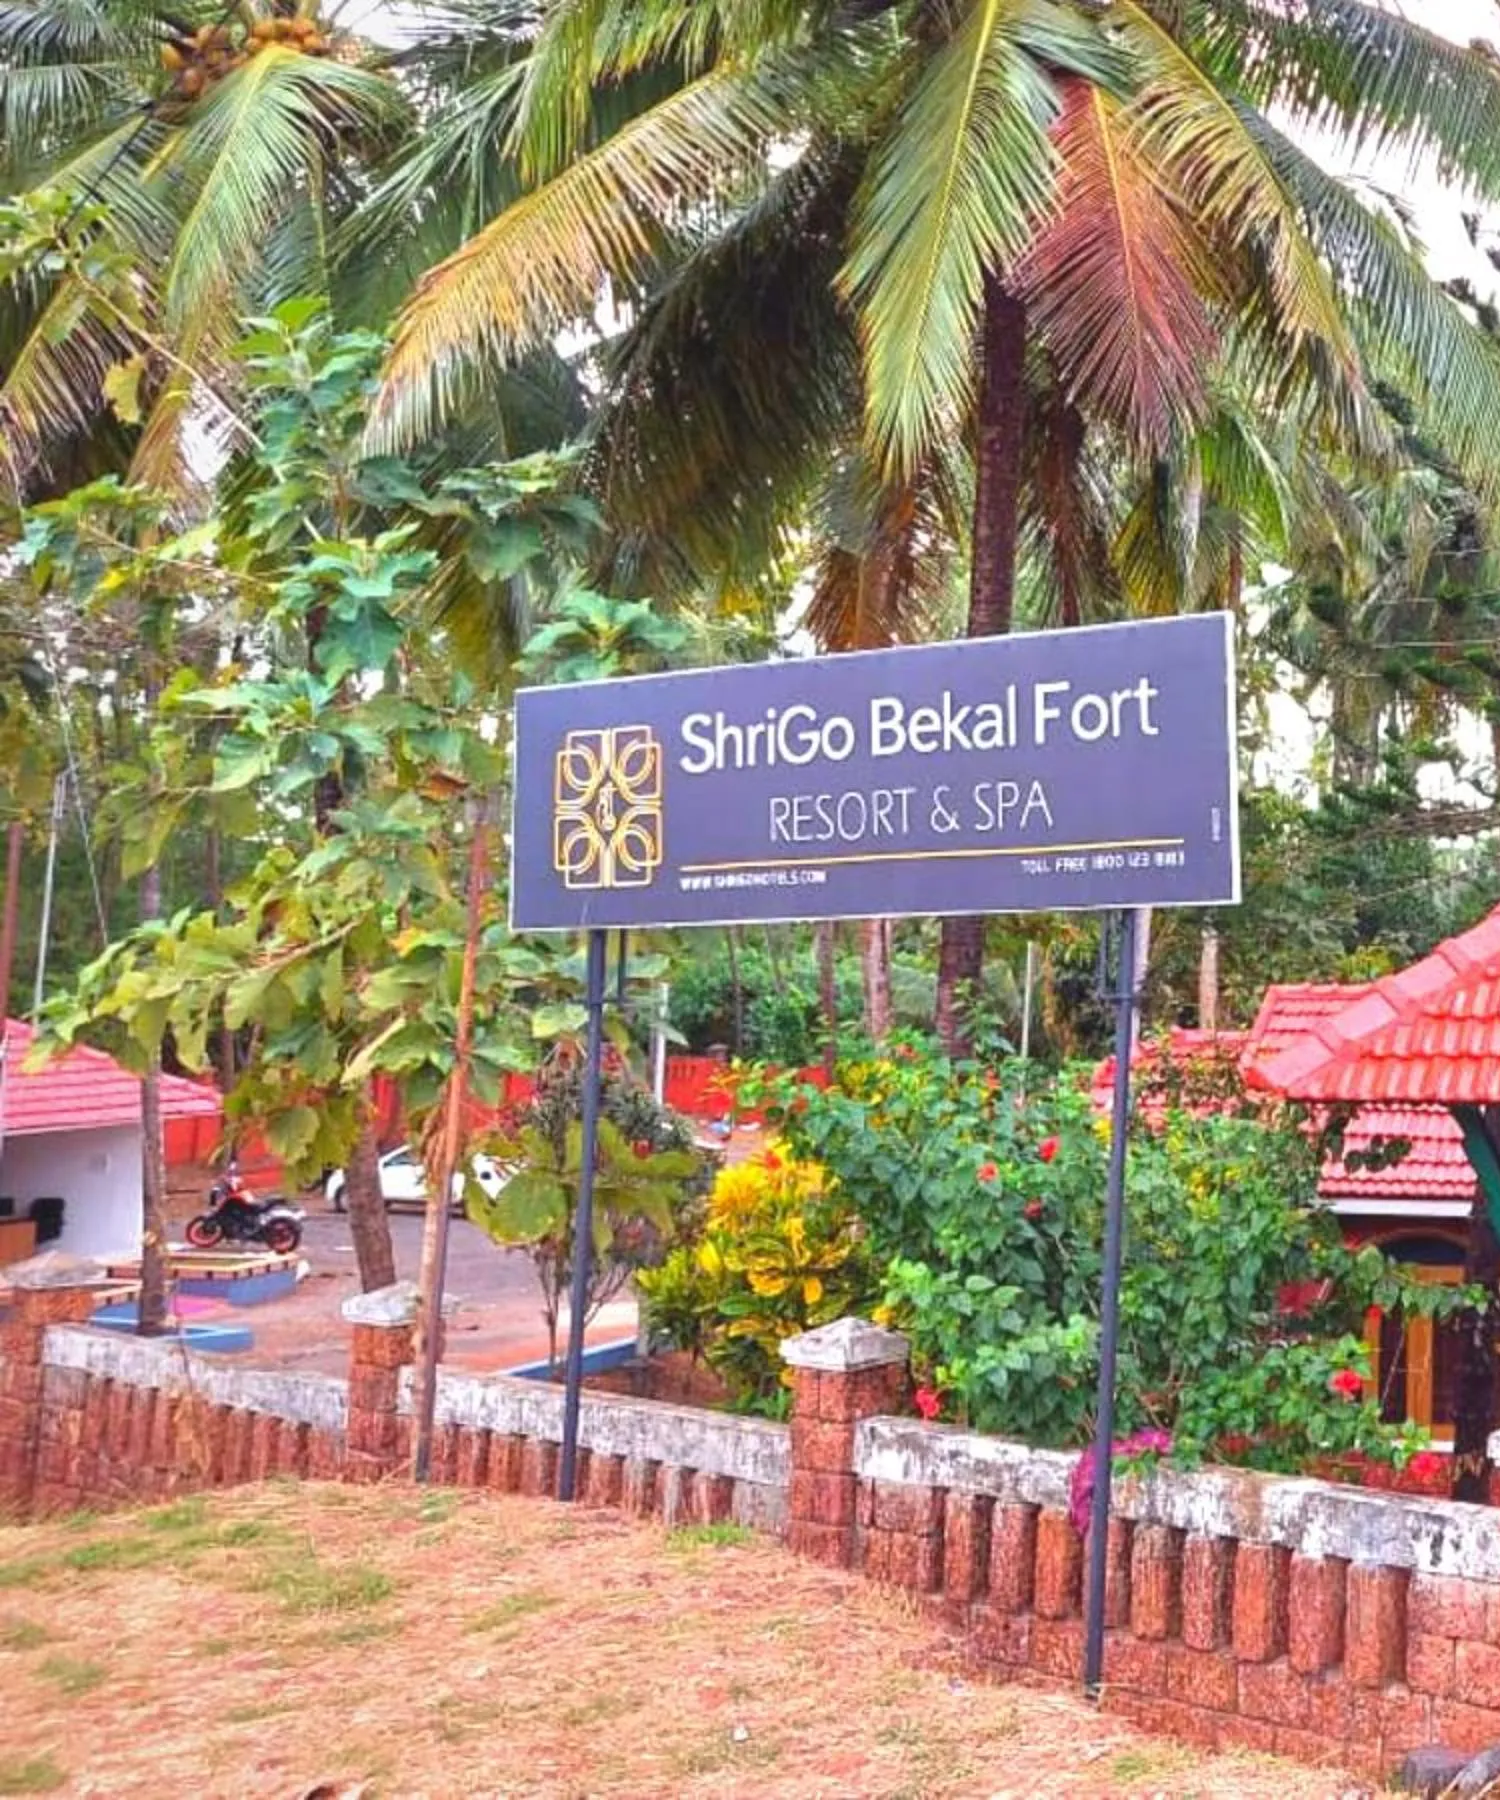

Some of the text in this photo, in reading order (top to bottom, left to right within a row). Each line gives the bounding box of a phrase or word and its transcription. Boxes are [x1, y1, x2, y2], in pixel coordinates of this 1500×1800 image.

[679, 677, 1161, 774] ShriGo Bekal Fort
[770, 780, 1055, 843] RESORT & SPA
[1055, 857, 1088, 873] FREE
